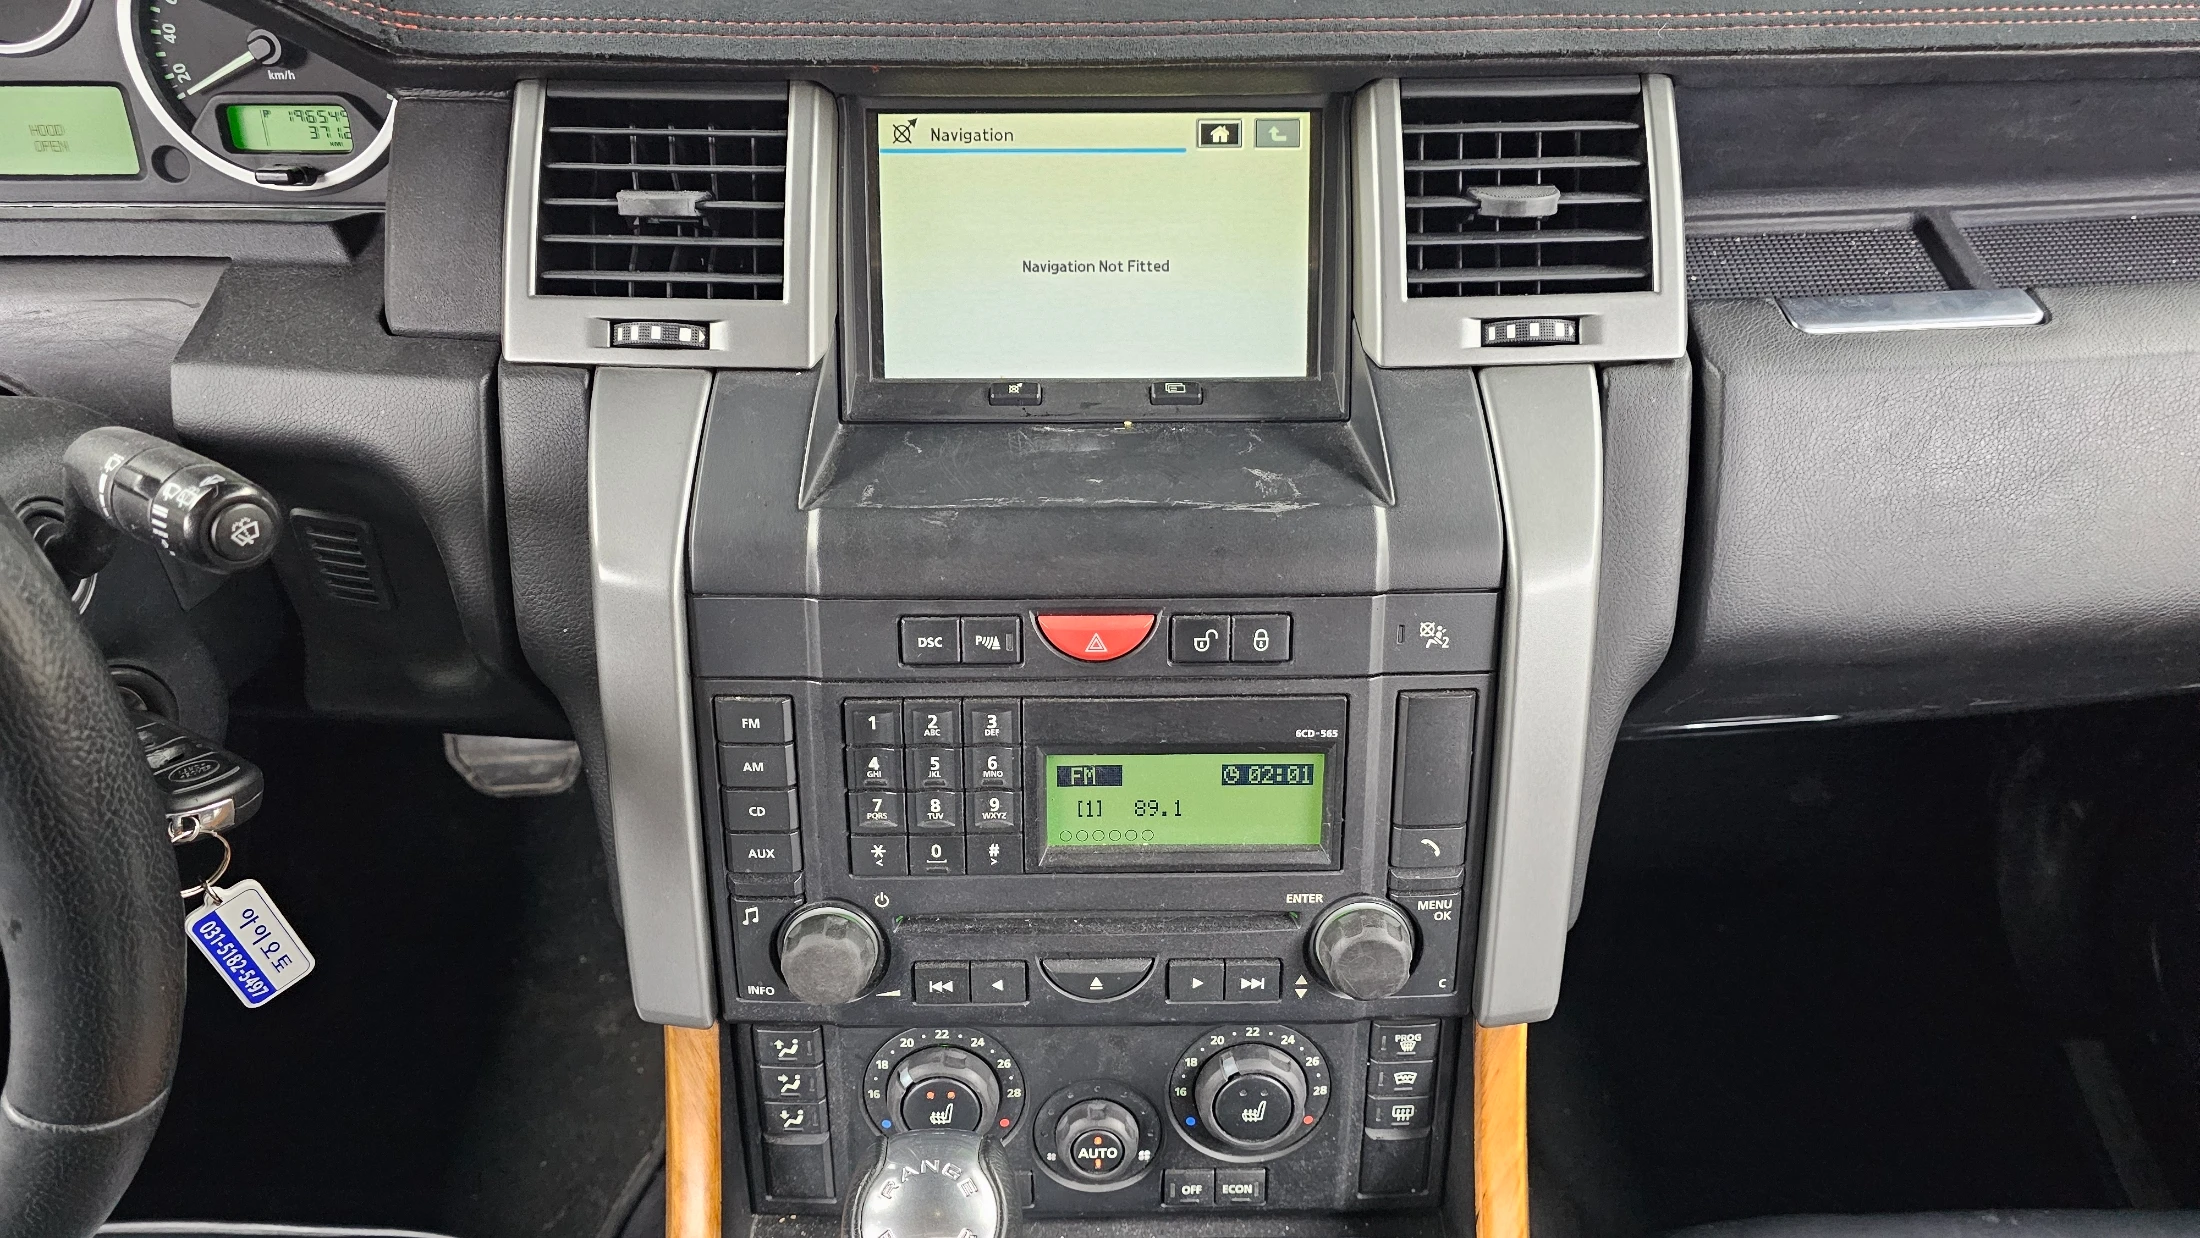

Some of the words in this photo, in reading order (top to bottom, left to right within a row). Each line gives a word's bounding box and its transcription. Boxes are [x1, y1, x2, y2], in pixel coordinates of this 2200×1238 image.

[162, 23, 177, 44] 40
[172, 63, 192, 84] 20
[267, 69, 296, 80] km/h
[28, 124, 66, 136] HOOD
[930, 127, 1014, 144] Navigation
[34, 140, 70, 152] OPEN
[1022, 260, 1096, 274] Navigation
[1099, 259, 1124, 273] Not
[1127, 259, 1170, 273] Fitted
[917, 636, 943, 648] DSC
[741, 718, 761, 729] FM
[867, 715, 876, 730] 1
[927, 714, 938, 729] 2
[986, 714, 998, 729] 3
[923, 728, 941, 737] ABC
[984, 728, 1000, 738] DEF
[1295, 729, 1339, 739] 6CD-565
[742, 762, 765, 772] AM
[867, 756, 880, 771] 4
[930, 756, 940, 771] 5
[987, 755, 998, 771] 6
[866, 770, 882, 778] GHI
[927, 770, 942, 778] JKL
[982, 770, 1004, 778] MNO
[1070, 766, 1097, 785] FM
[1248, 765, 1311, 785] 02:01
[872, 798, 883, 813] 7
[930, 798, 941, 813] 8
[989, 797, 1000, 812] 9
[1078, 800, 1102, 818] [1]
[1134, 800, 1182, 817] 89.1
[748, 806, 766, 817] CD
[866, 812, 888, 820] PQRS
[927, 812, 944, 820] TUV
[982, 812, 1007, 820] WXYZ
[748, 848, 776, 859] AUX
[931, 843, 942, 859] 0
[1286, 893, 1324, 904] ENTER
[1417, 899, 1453, 911] MENU
[1433, 911, 1451, 921] OK
[240, 908, 293, 974] 아이오토
[199, 920, 270, 998] 031-5182-5497
[1438, 978, 1447, 989] C
[747, 985, 776, 996] INFO
[1394, 1033, 1422, 1043] PROG
[867, 1089, 881, 1099] 16
[875, 1059, 889, 1070] 18
[900, 1037, 915, 1048] 20
[934, 1029, 950, 1039] 22
[970, 1037, 985, 1047] 24
[997, 1058, 1012, 1069] 26
[1007, 1088, 1022, 1098] 28
[1174, 1087, 1187, 1097] 16
[1185, 1057, 1198, 1068] 18
[1210, 1035, 1225, 1046] 20
[1245, 1026, 1260, 1037] 22
[1280, 1034, 1296, 1045] 24
[1305, 1056, 1320, 1067] 26
[1313, 1085, 1328, 1096] 28
[1077, 1147, 1118, 1159] AUTO
[880, 1159, 979, 1200] RANGE
[1181, 1184, 1203, 1196] OFF
[1222, 1183, 1253, 1194] ECON
